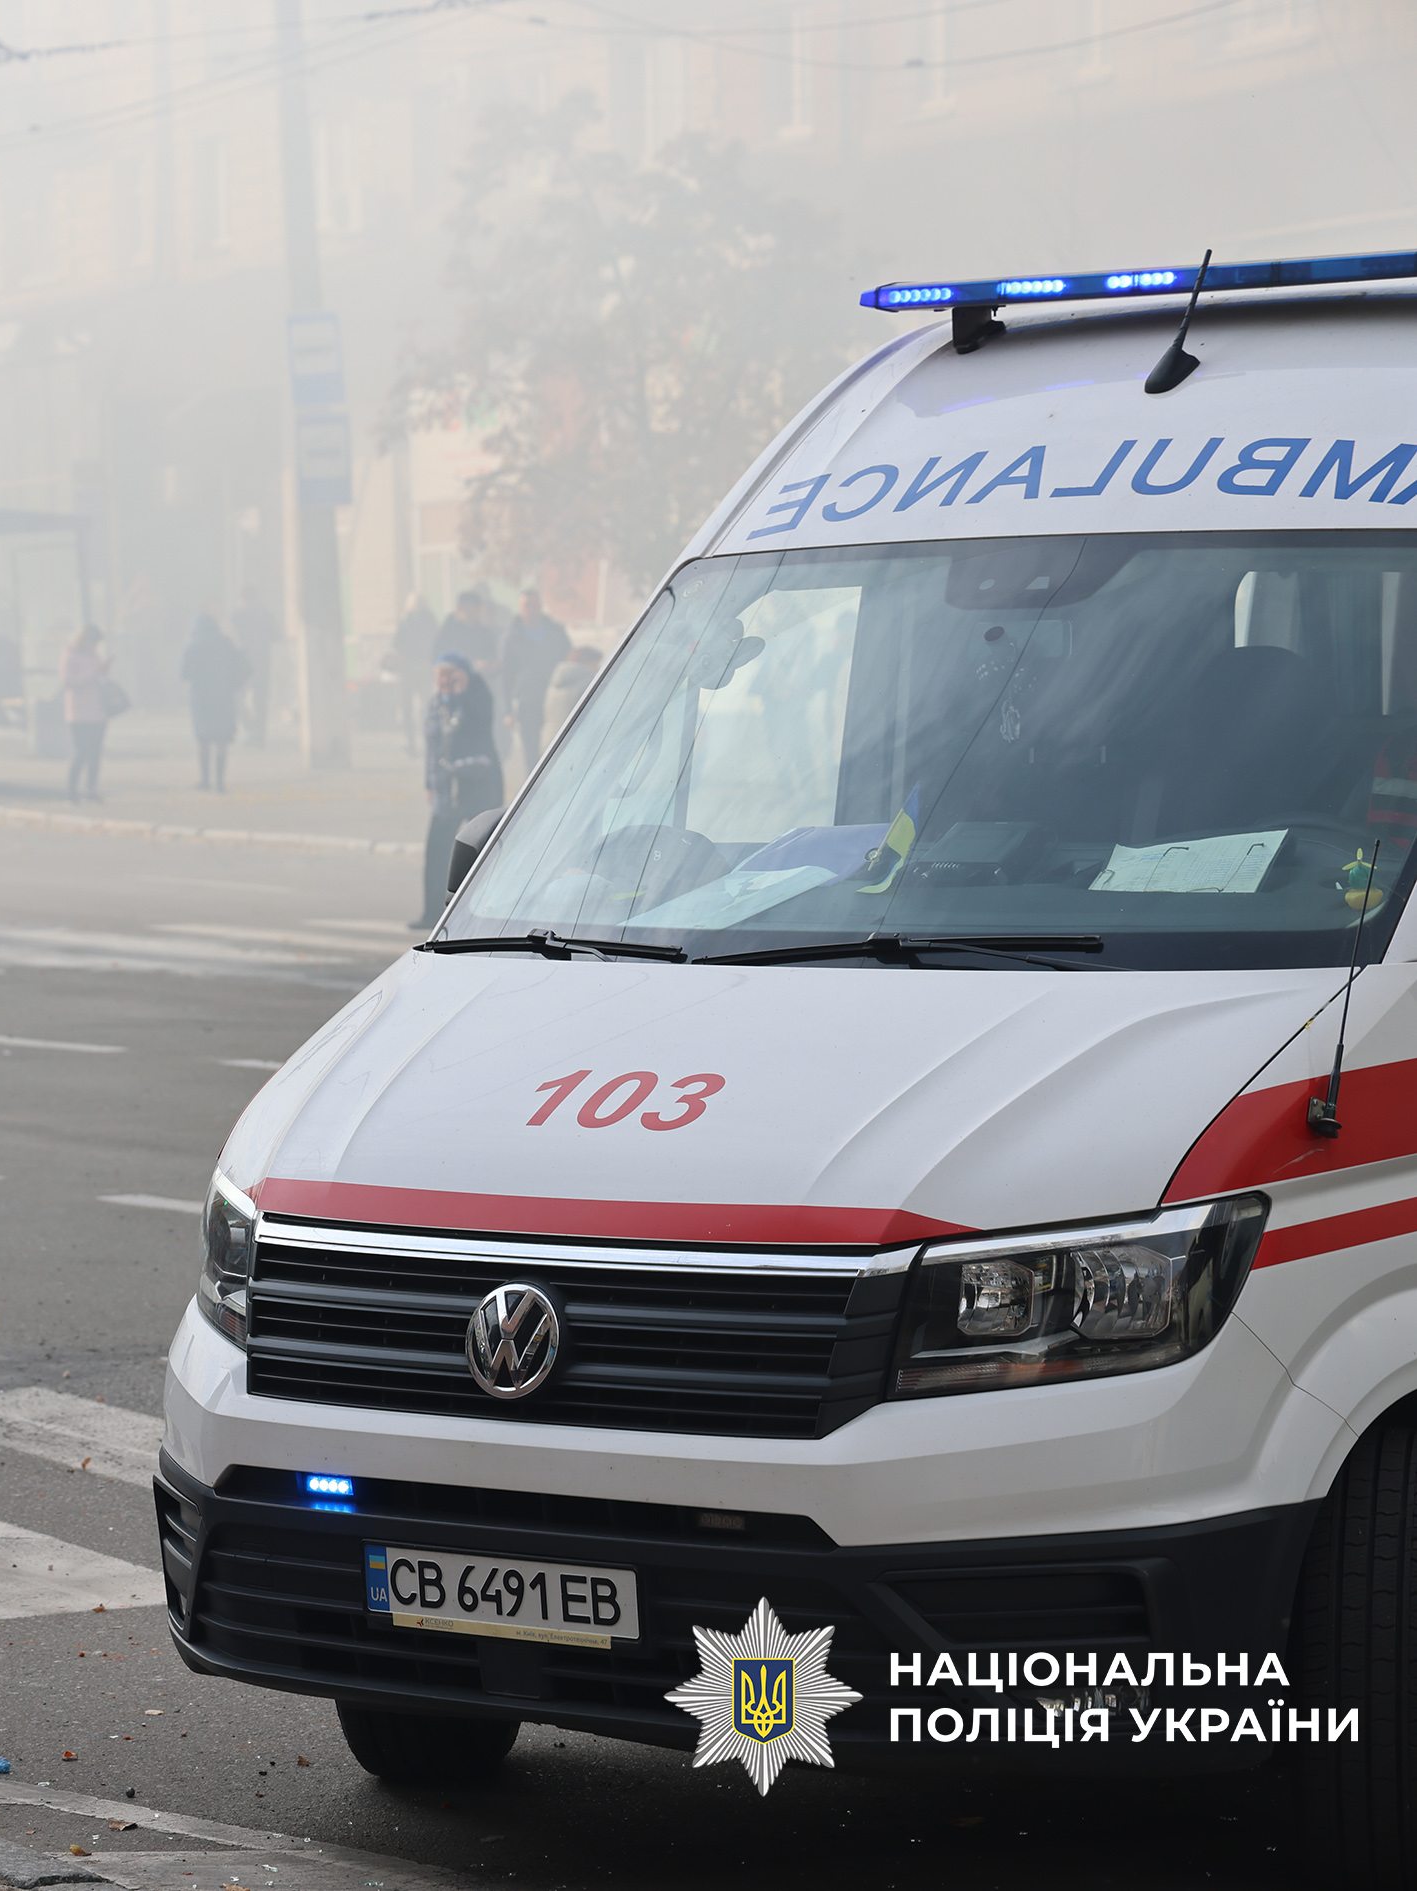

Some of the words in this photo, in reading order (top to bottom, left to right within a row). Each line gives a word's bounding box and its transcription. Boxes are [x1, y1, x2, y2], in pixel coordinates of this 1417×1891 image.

[525, 1069, 726, 1132] 103
[370, 1586, 388, 1602] UA
[456, 1564, 549, 1620] 6491
